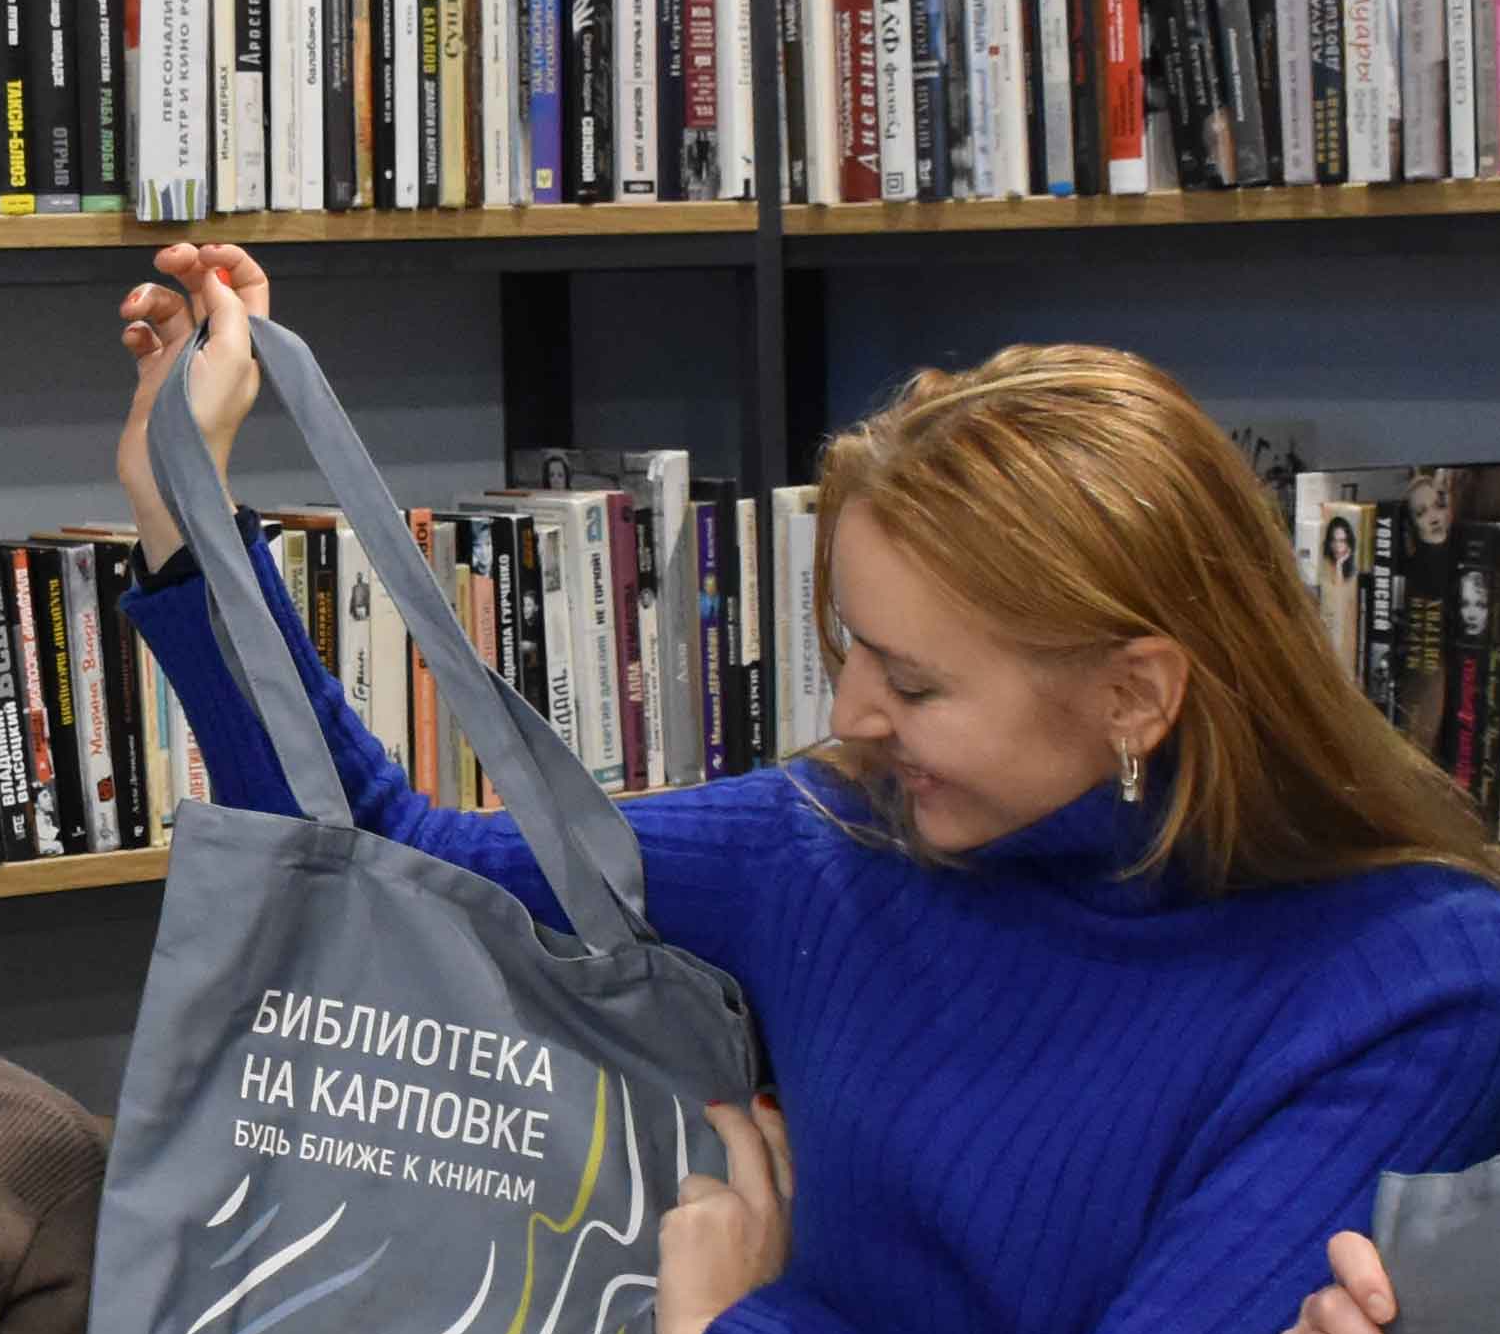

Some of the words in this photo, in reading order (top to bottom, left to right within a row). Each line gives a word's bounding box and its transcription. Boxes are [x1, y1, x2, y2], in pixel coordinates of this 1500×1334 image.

[179, 23, 189, 80] КИНО
[423, 7, 436, 72] БАТАЛОВ
[179, 88, 189, 102] И
[220, 65, 228, 125] АВЕРБАХ
[861, 9, 881, 174] Дневники
[6, 80, 25, 186] ТАКСИ-БЛЮЗ
[53, 127, 70, 185] ОТРЫВ
[179, 110, 189, 167] ТЕАТР
[499, 555, 512, 624] ГУРЧЕНКО
[81, 611, 98, 672] Влади
[3, 701, 28, 803] ВЫСОЦКИЙ
[88, 681, 104, 755] Марина
[252, 989, 553, 1092] БИБЛИОТЕКА
[242, 1054, 294, 1108] НА
[311, 1067, 549, 1159] КАРПОВКЕ
[234, 1120, 290, 1157] БУДЬ
[300, 1133, 395, 1176] БЛИЖЕ
[404, 1155, 421, 1182] К
[429, 1159, 536, 1205] КНИГАМ
